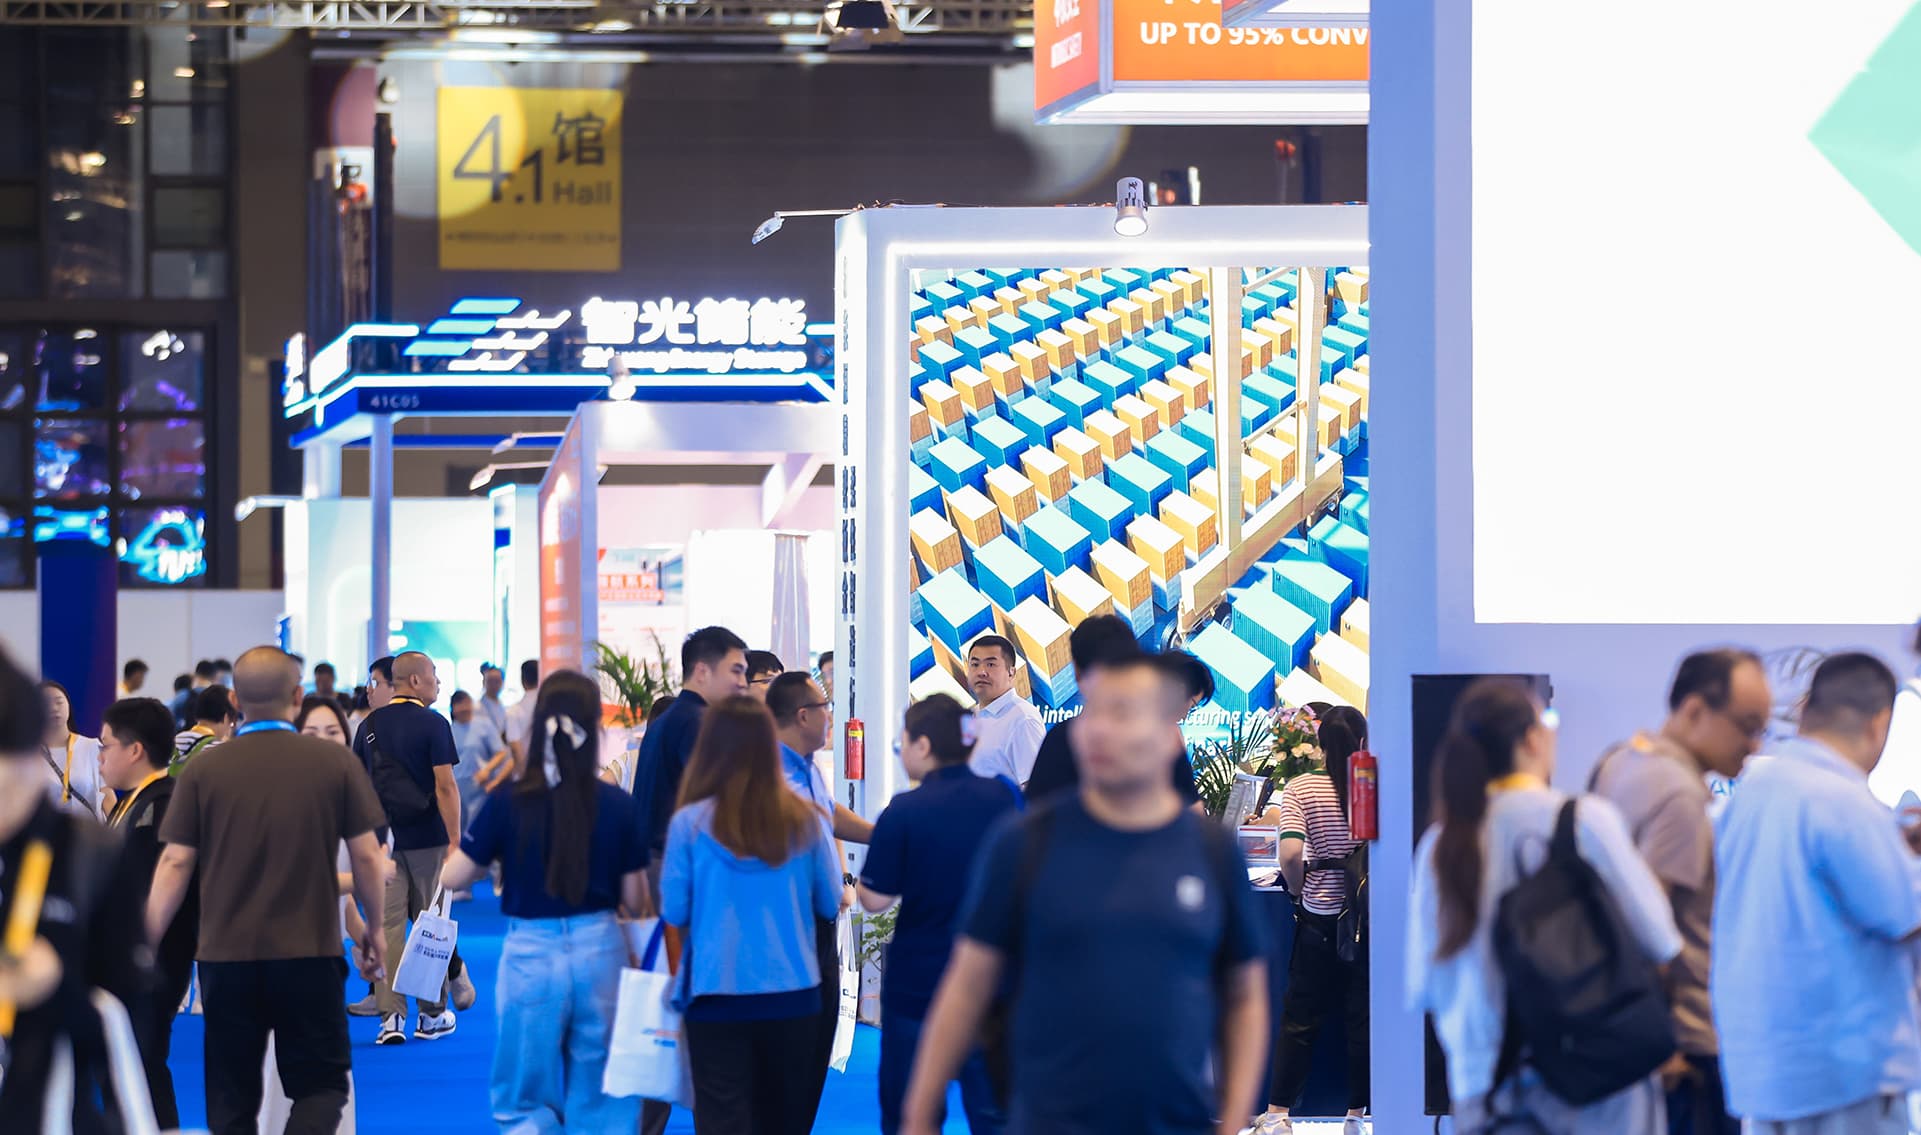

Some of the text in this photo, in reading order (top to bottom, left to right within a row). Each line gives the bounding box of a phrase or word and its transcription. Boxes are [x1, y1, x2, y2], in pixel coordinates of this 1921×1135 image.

[1141, 21, 1368, 46] UP TO 95% CONV
[454, 113, 544, 203] 4.1
[553, 110, 606, 166] 馆
[553, 181, 612, 204] Hall
